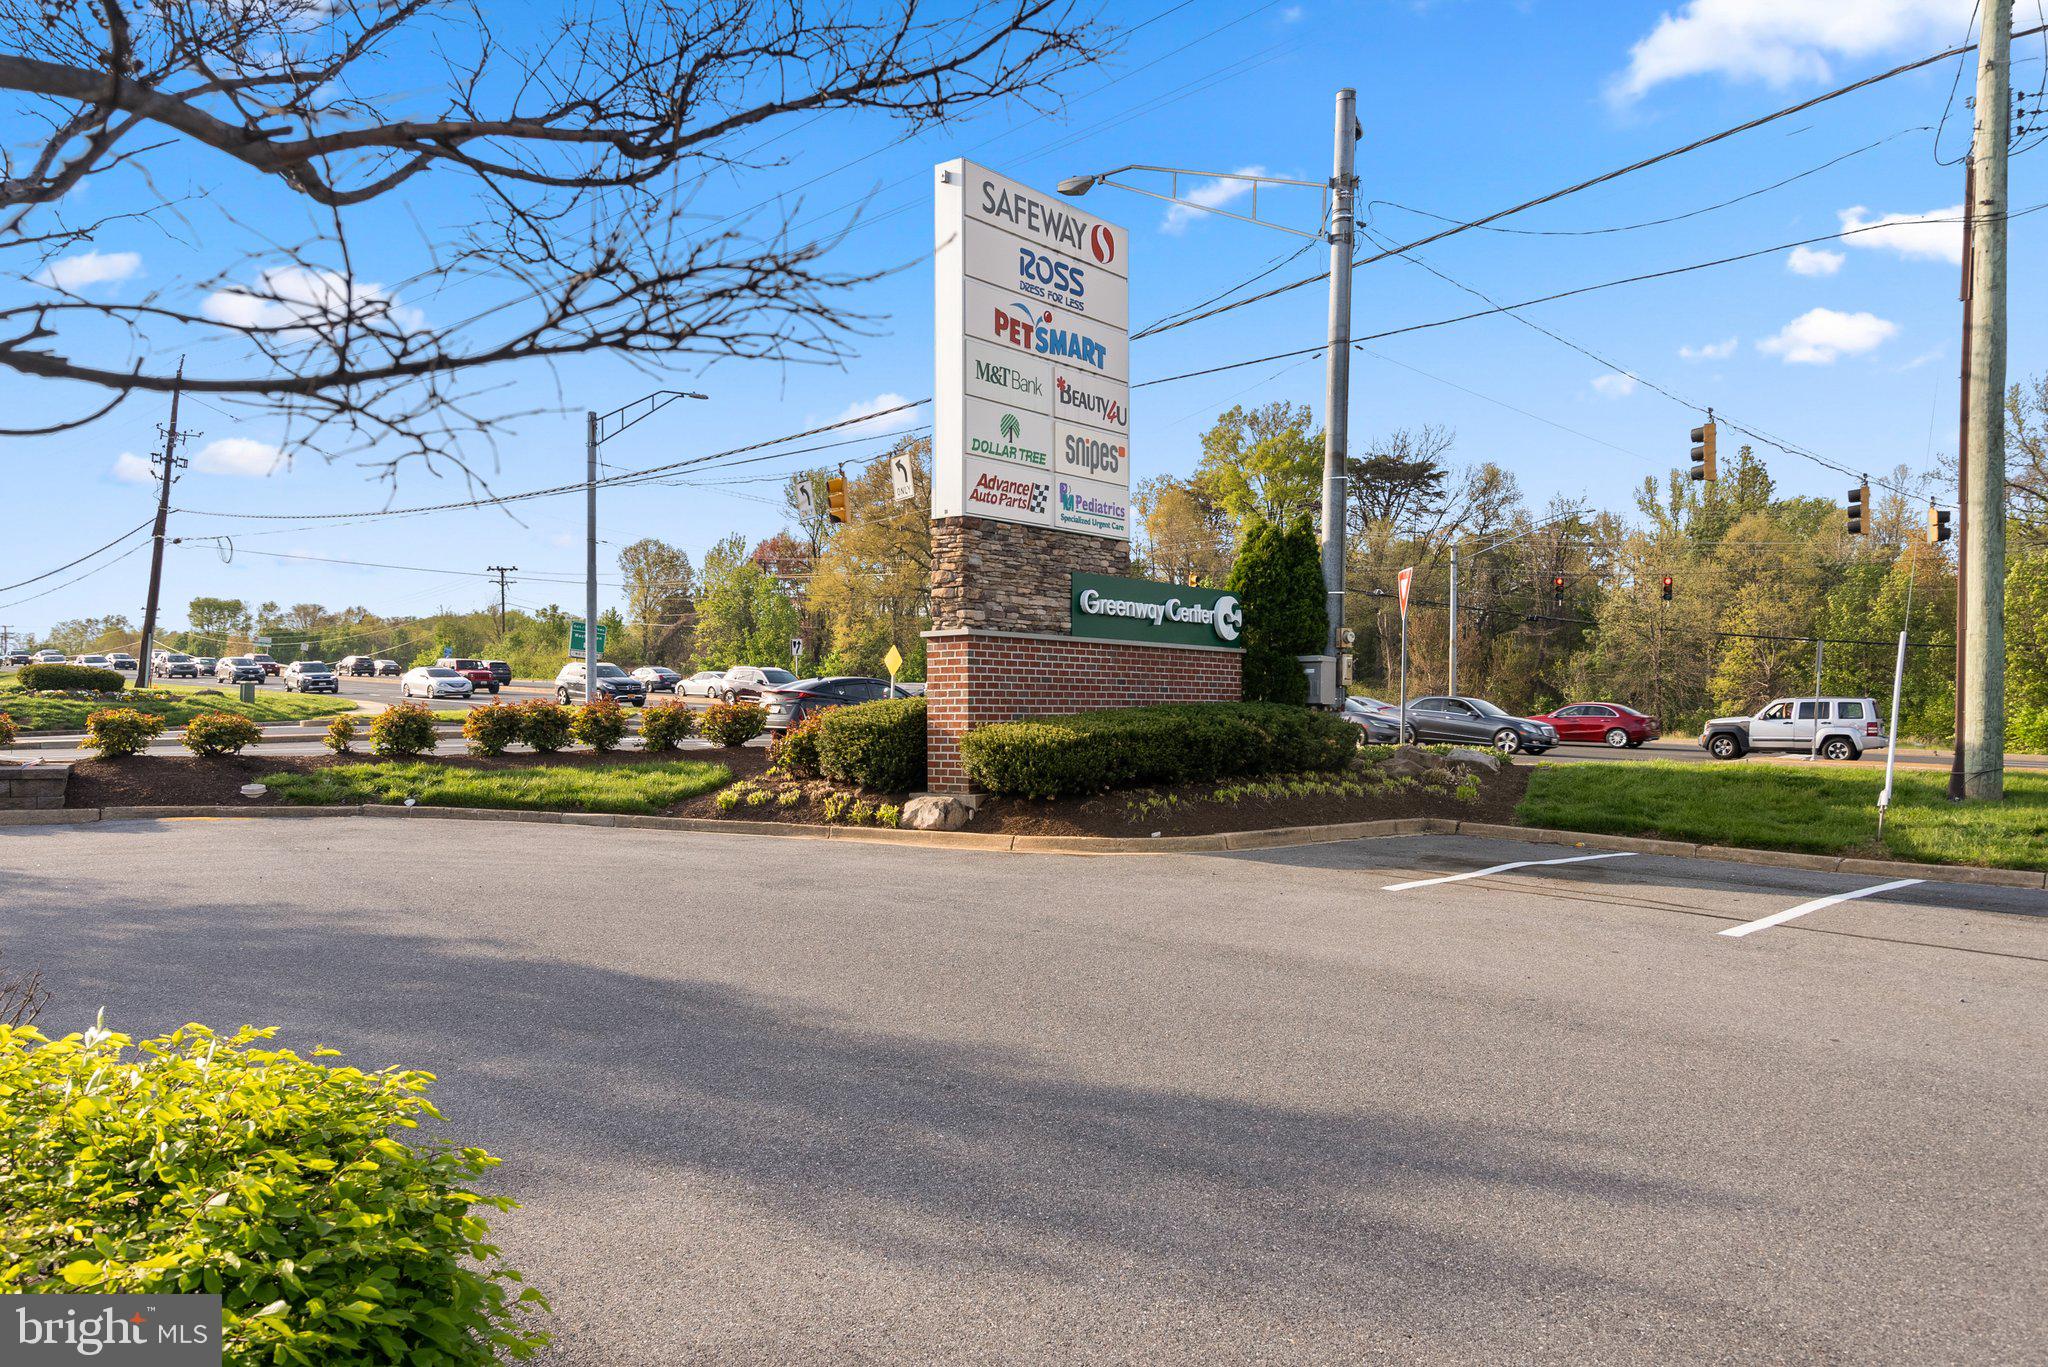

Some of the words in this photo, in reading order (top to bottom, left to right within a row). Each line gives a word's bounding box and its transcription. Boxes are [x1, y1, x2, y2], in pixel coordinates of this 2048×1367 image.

[982, 181, 1087, 249] SAFEWAY
[1019, 247, 1085, 297] ROSS
[1019, 281, 1045, 297] DRESS
[1047, 291, 1063, 304] FOR
[1065, 297, 1085, 311] LESS
[994, 307, 1106, 370] PETSMART
[975, 359, 1011, 387] M&T
[1012, 370, 1043, 396] Bank
[971, 438, 1017, 459] DOLLAR
[1018, 448, 1047, 465] TREE
[896, 485, 911, 496] ONLY
[968, 488, 997, 504] Auto
[998, 494, 1028, 509] Parts
[976, 473, 1030, 496] Advance
[1075, 495, 1125, 517] Pediatrics
[1060, 513, 1091, 526] Specialized
[1092, 518, 1111, 529] Urgent
[1111, 522, 1124, 531] Care
[1080, 589, 1165, 625] Greenway
[1165, 598, 1215, 624] Center
